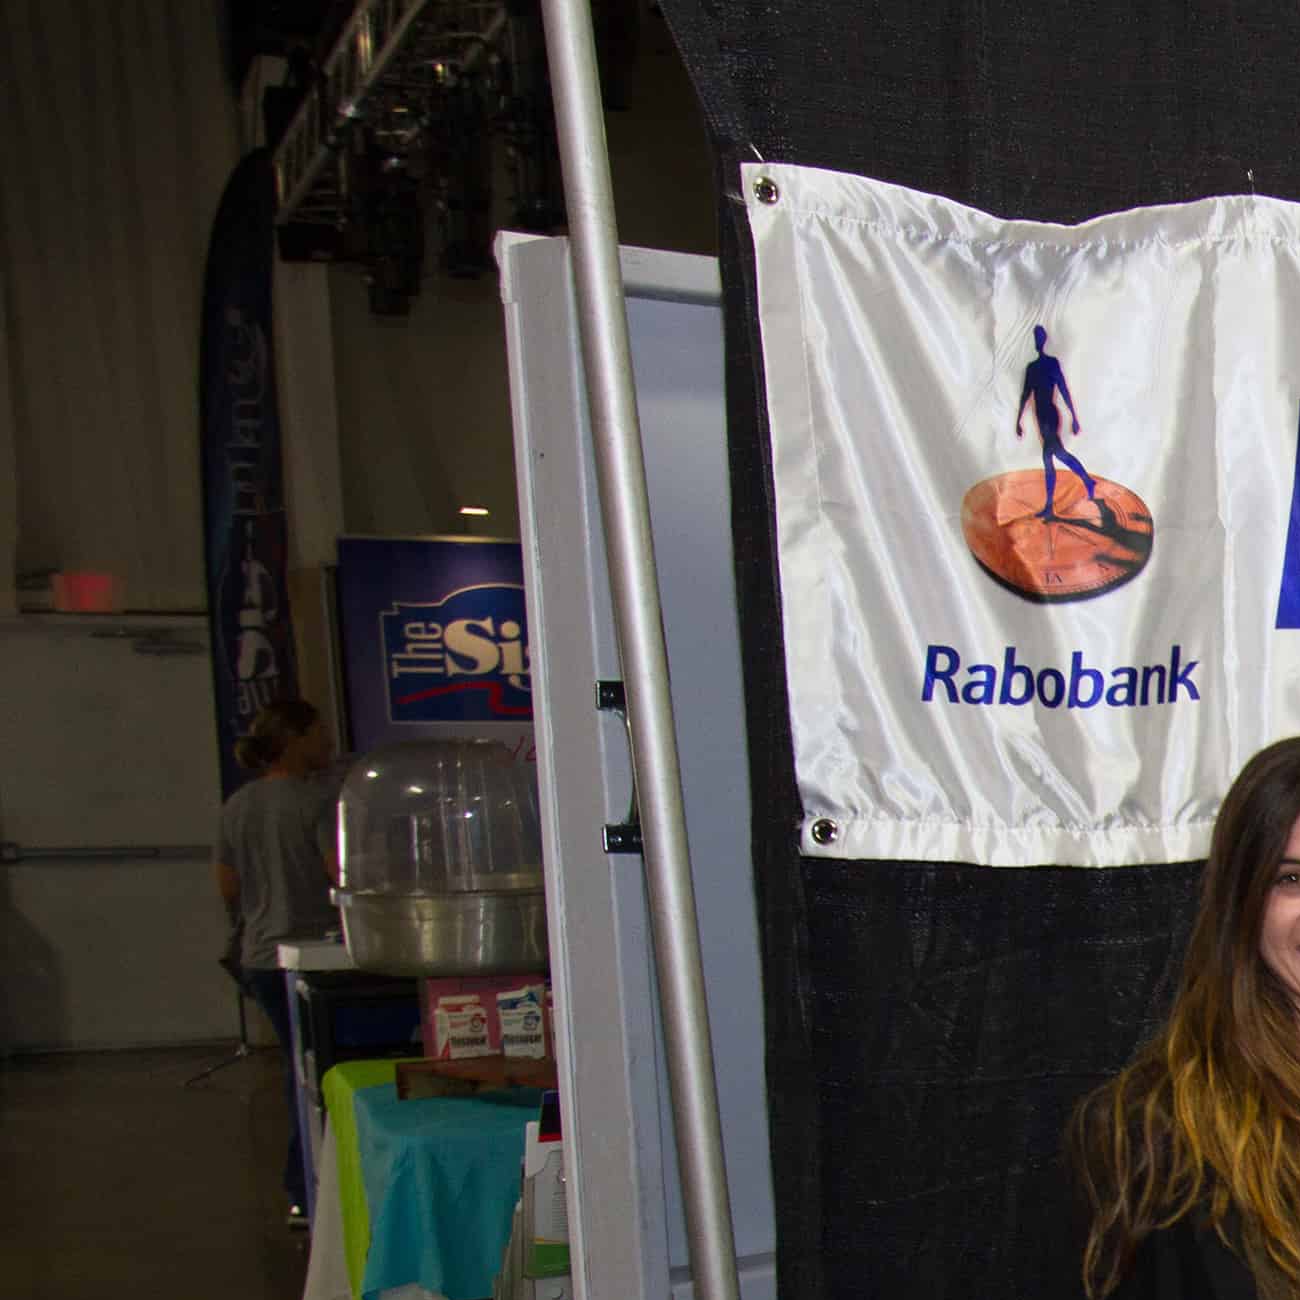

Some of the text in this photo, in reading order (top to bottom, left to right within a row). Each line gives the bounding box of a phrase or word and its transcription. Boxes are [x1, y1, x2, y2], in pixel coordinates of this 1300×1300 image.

[392, 615, 531, 685] The Si
[921, 644, 1201, 709] Rabobank
